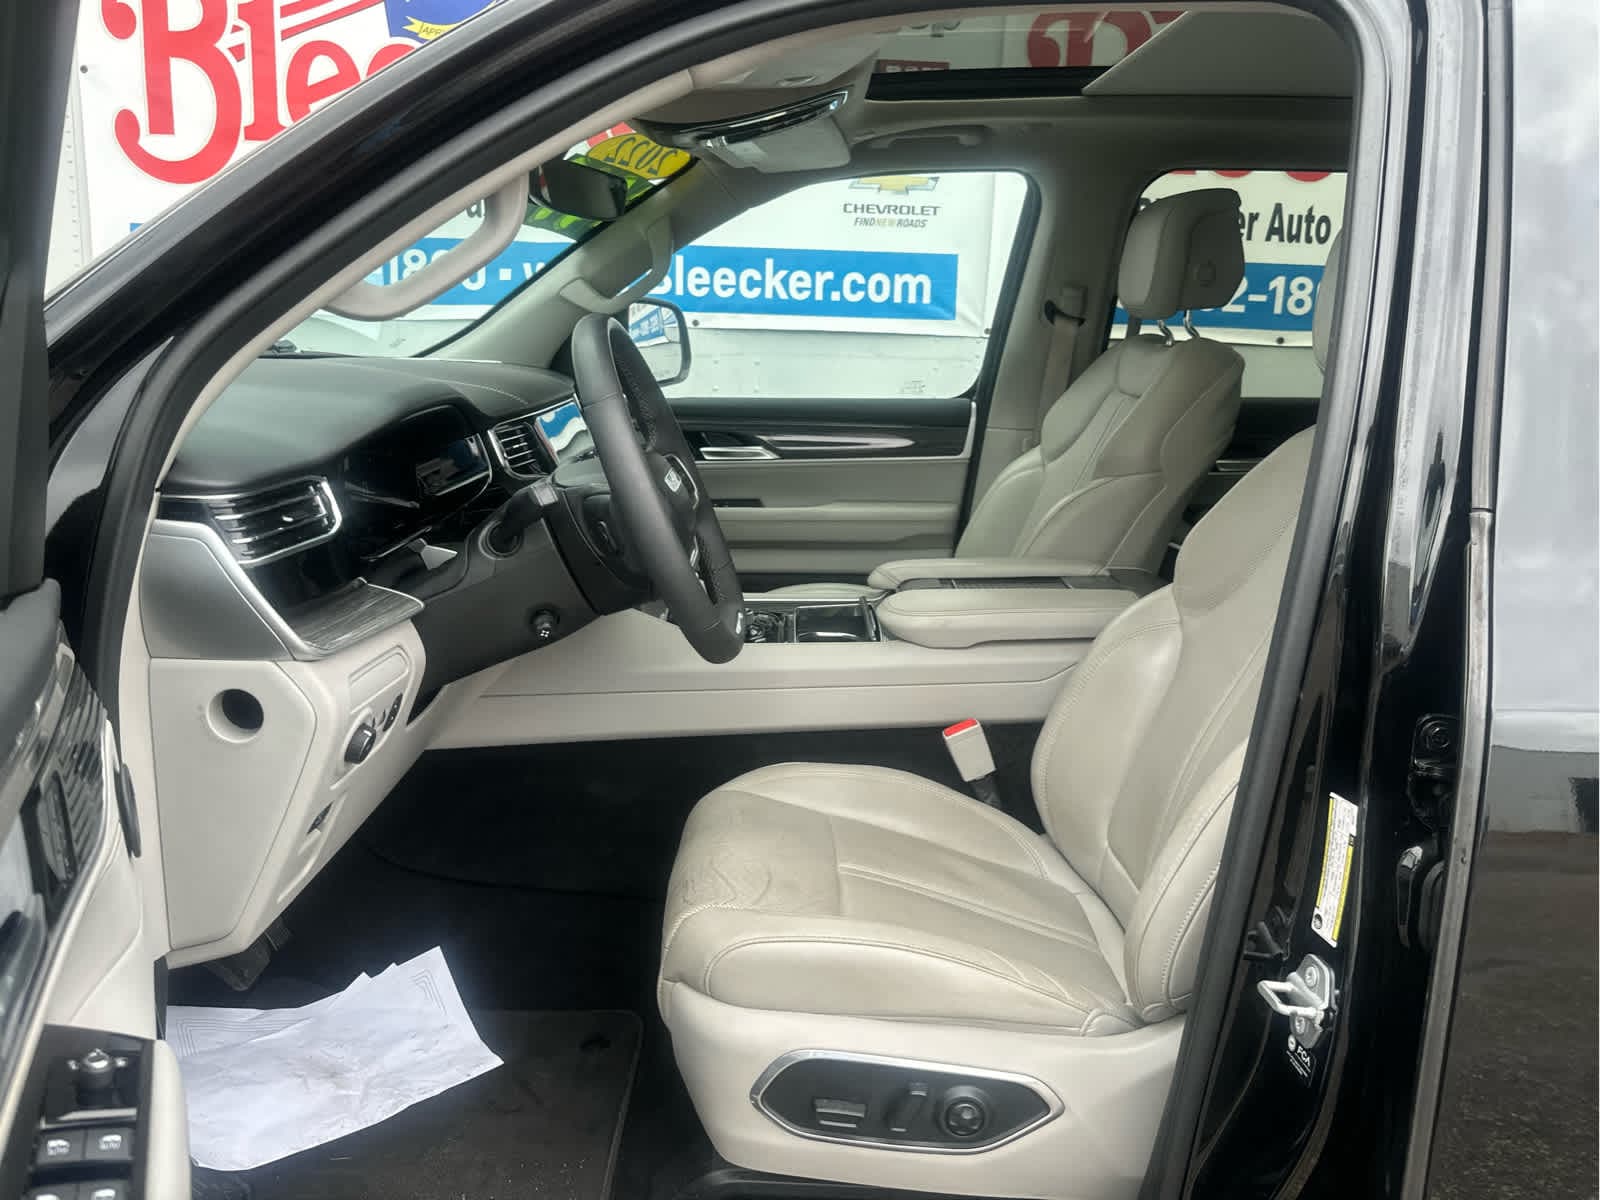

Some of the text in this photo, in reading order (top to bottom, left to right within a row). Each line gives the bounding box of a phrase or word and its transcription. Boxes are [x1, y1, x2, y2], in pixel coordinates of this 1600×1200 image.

[102, 0, 416, 185] Ble
[842, 202, 942, 216] CHEVROLET
[1265, 202, 1332, 245] Auto
